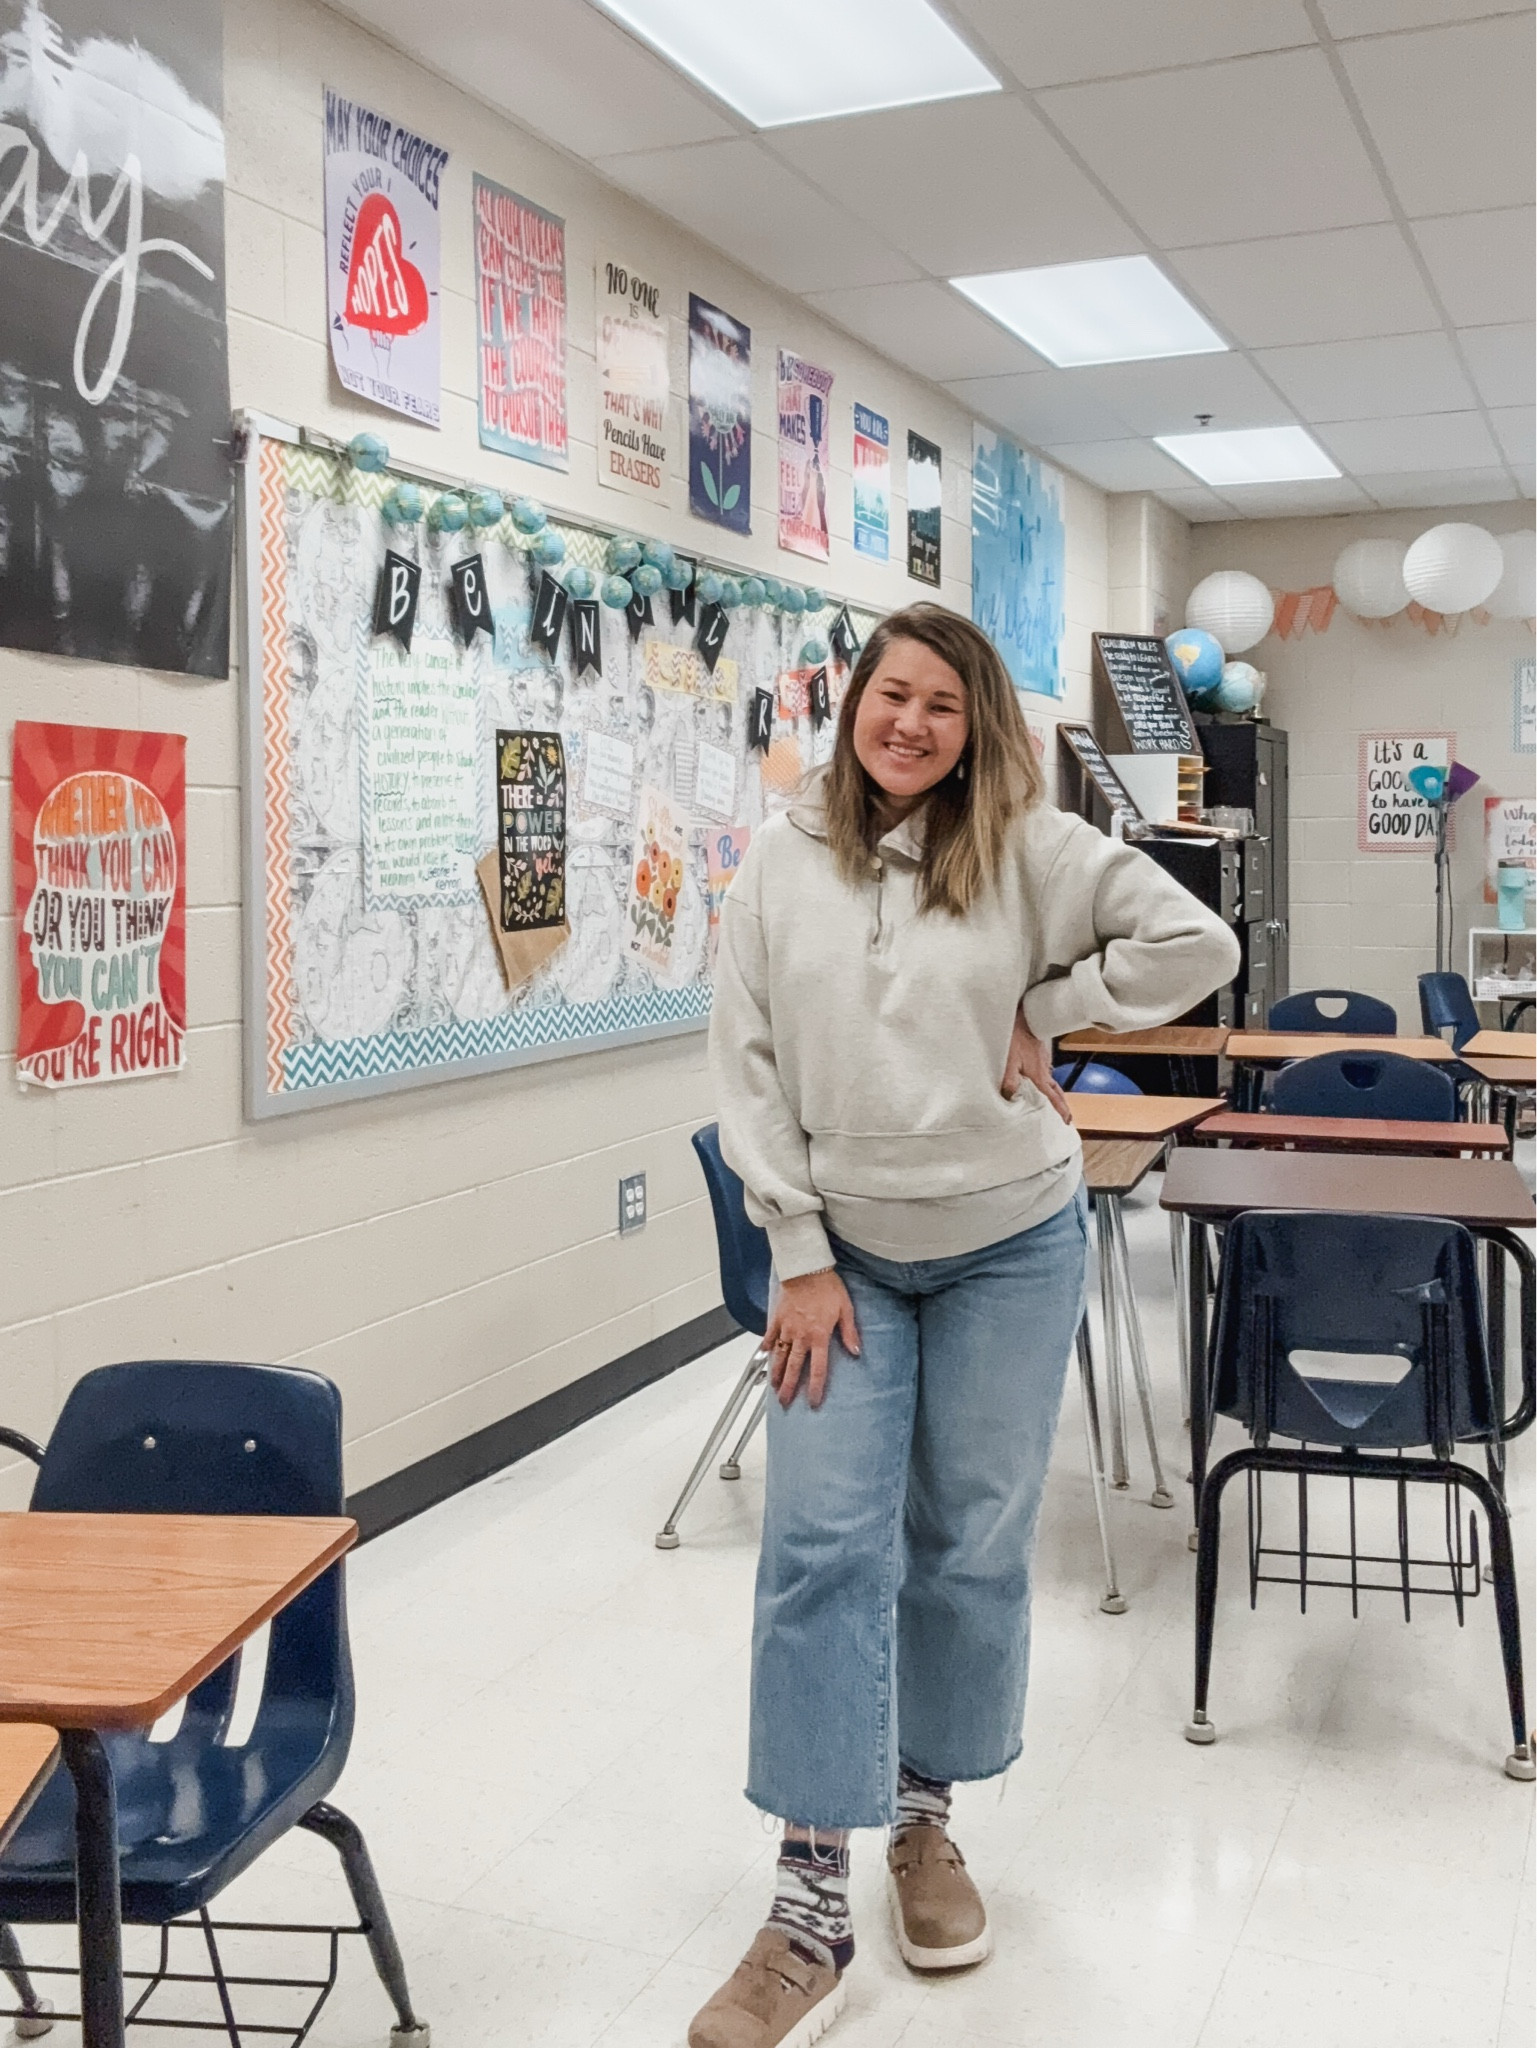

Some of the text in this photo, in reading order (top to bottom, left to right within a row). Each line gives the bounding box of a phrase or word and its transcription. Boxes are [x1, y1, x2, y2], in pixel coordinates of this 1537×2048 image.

[326, 89, 449, 211] MAY YOUR CHOICES
[339, 166, 383, 275] REFLECT YOUR
[351, 212, 409, 318] HOPES
[605, 262, 660, 319] NO ONE
[628, 302, 640, 320] IS
[480, 277, 496, 341] IF
[499, 282, 523, 342] WE
[529, 295, 565, 360] HAVE
[480, 343, 508, 393] THE
[338, 364, 440, 423] NOT YOUR FEARS
[481, 387, 499, 433] TO
[603, 390, 641, 422] THAT'S
[603, 418, 667, 462] Pencils Have
[779, 412, 806, 445] MAKES
[609, 450, 661, 489] ERASERS
[1374, 740, 1429, 764] it's a
[500, 784, 535, 809] THERE
[1368, 769, 1412, 793] GOO
[1371, 794, 1388, 809] to
[1392, 793, 1426, 808] have
[38, 774, 164, 840] WHETHER YOU
[502, 811, 563, 835] POWER
[1368, 812, 1448, 839] GOOD DA
[1503, 804, 1536, 825] Wha
[36, 830, 174, 892] THINK YOU CAN
[515, 835, 529, 852] THE
[531, 834, 552, 851] WORD
[716, 834, 741, 869] Be
[1505, 834, 1536, 847] toda
[33, 888, 171, 952] OR YOU THINK
[39, 941, 161, 1012] YOU CAN'T
[18, 1001, 184, 1082] YOU'RE RIGHT
